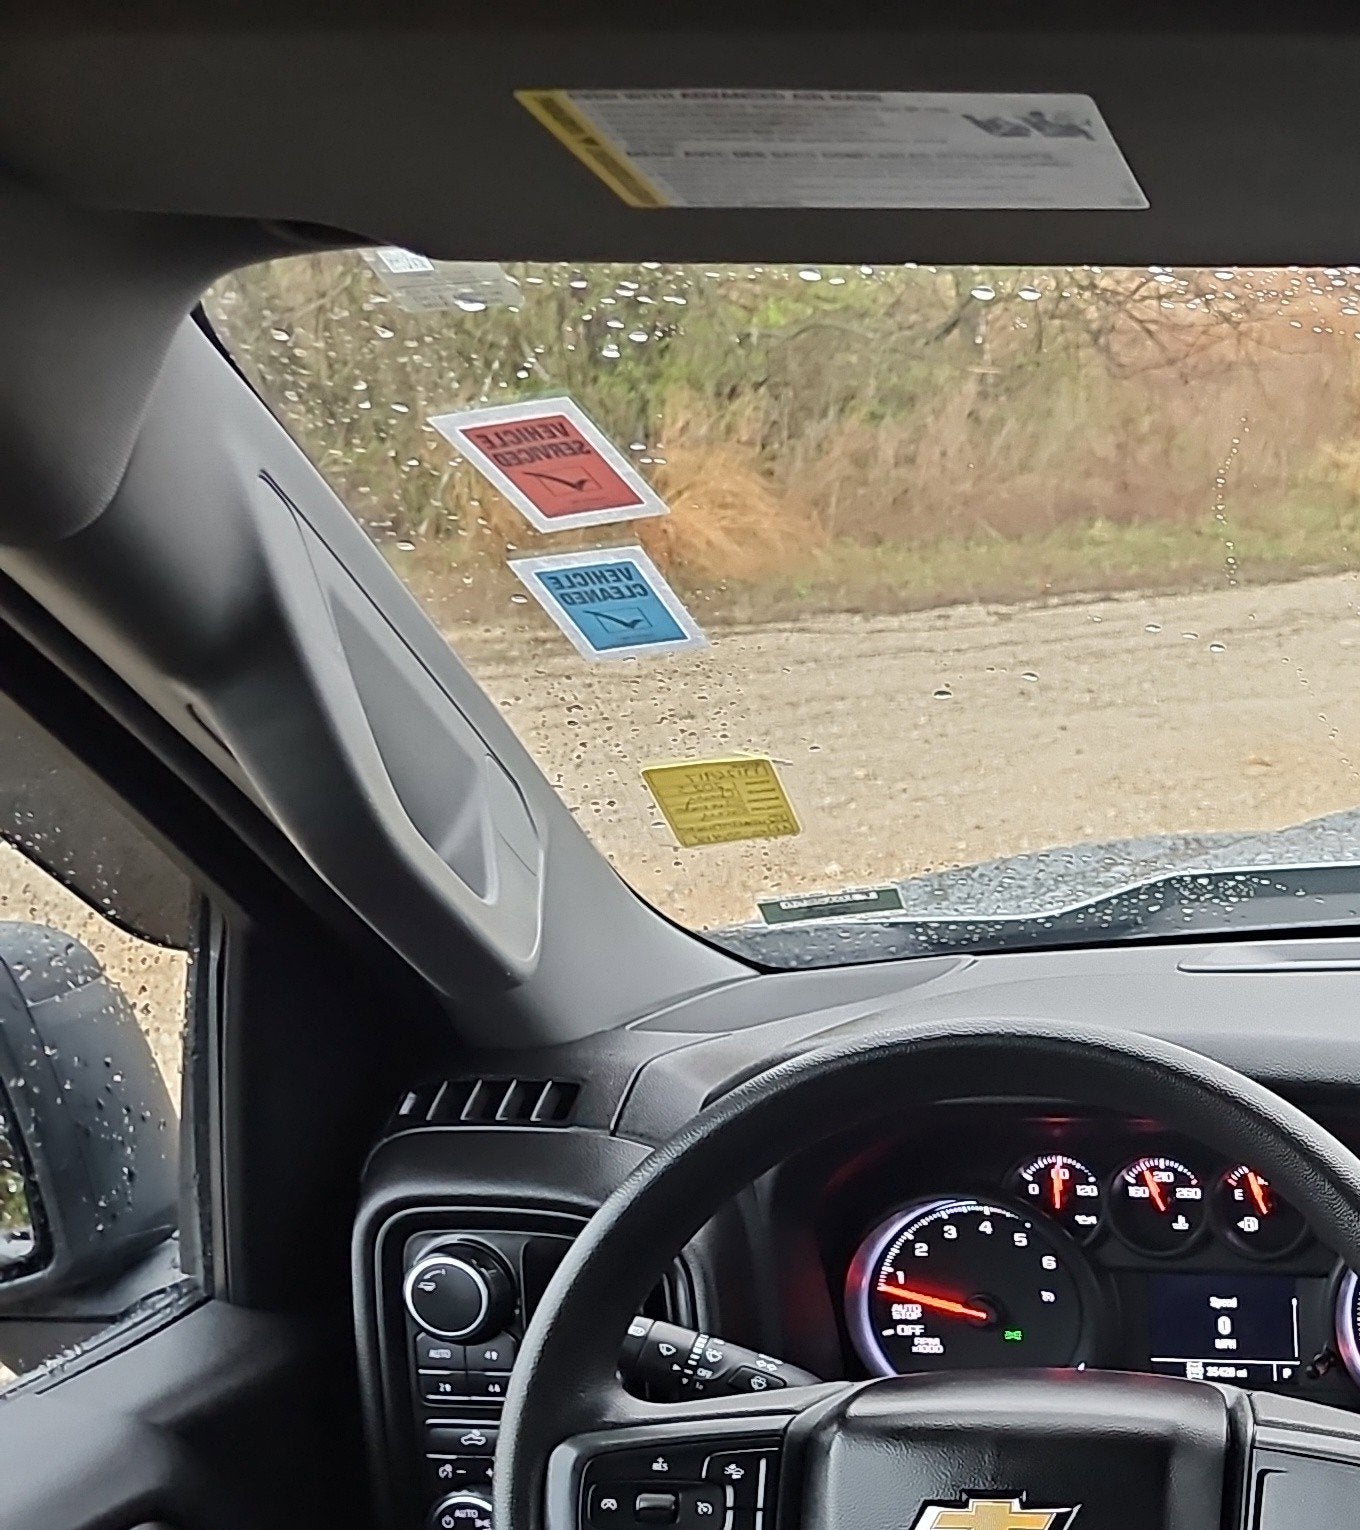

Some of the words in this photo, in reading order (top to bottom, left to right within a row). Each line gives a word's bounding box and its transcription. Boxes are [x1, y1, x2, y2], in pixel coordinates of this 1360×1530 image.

[1152, 1171, 1175, 1183] 210
[1027, 1183, 1040, 1195] 0
[1075, 1184, 1099, 1197] 120
[1233, 1188, 1245, 1201] E
[942, 1224, 958, 1239] 3
[978, 1220, 994, 1235] 4
[1013, 1232, 1028, 1247] 5
[914, 1242, 929, 1257] 2
[1041, 1255, 1058, 1270] 6
[896, 1270, 906, 1285] 1
[896, 1324, 925, 1336] OFF
[1217, 1315, 1232, 1336] 0
[1282, 1367, 1293, 1379] P
[454, 1508, 479, 1519] AUTO
